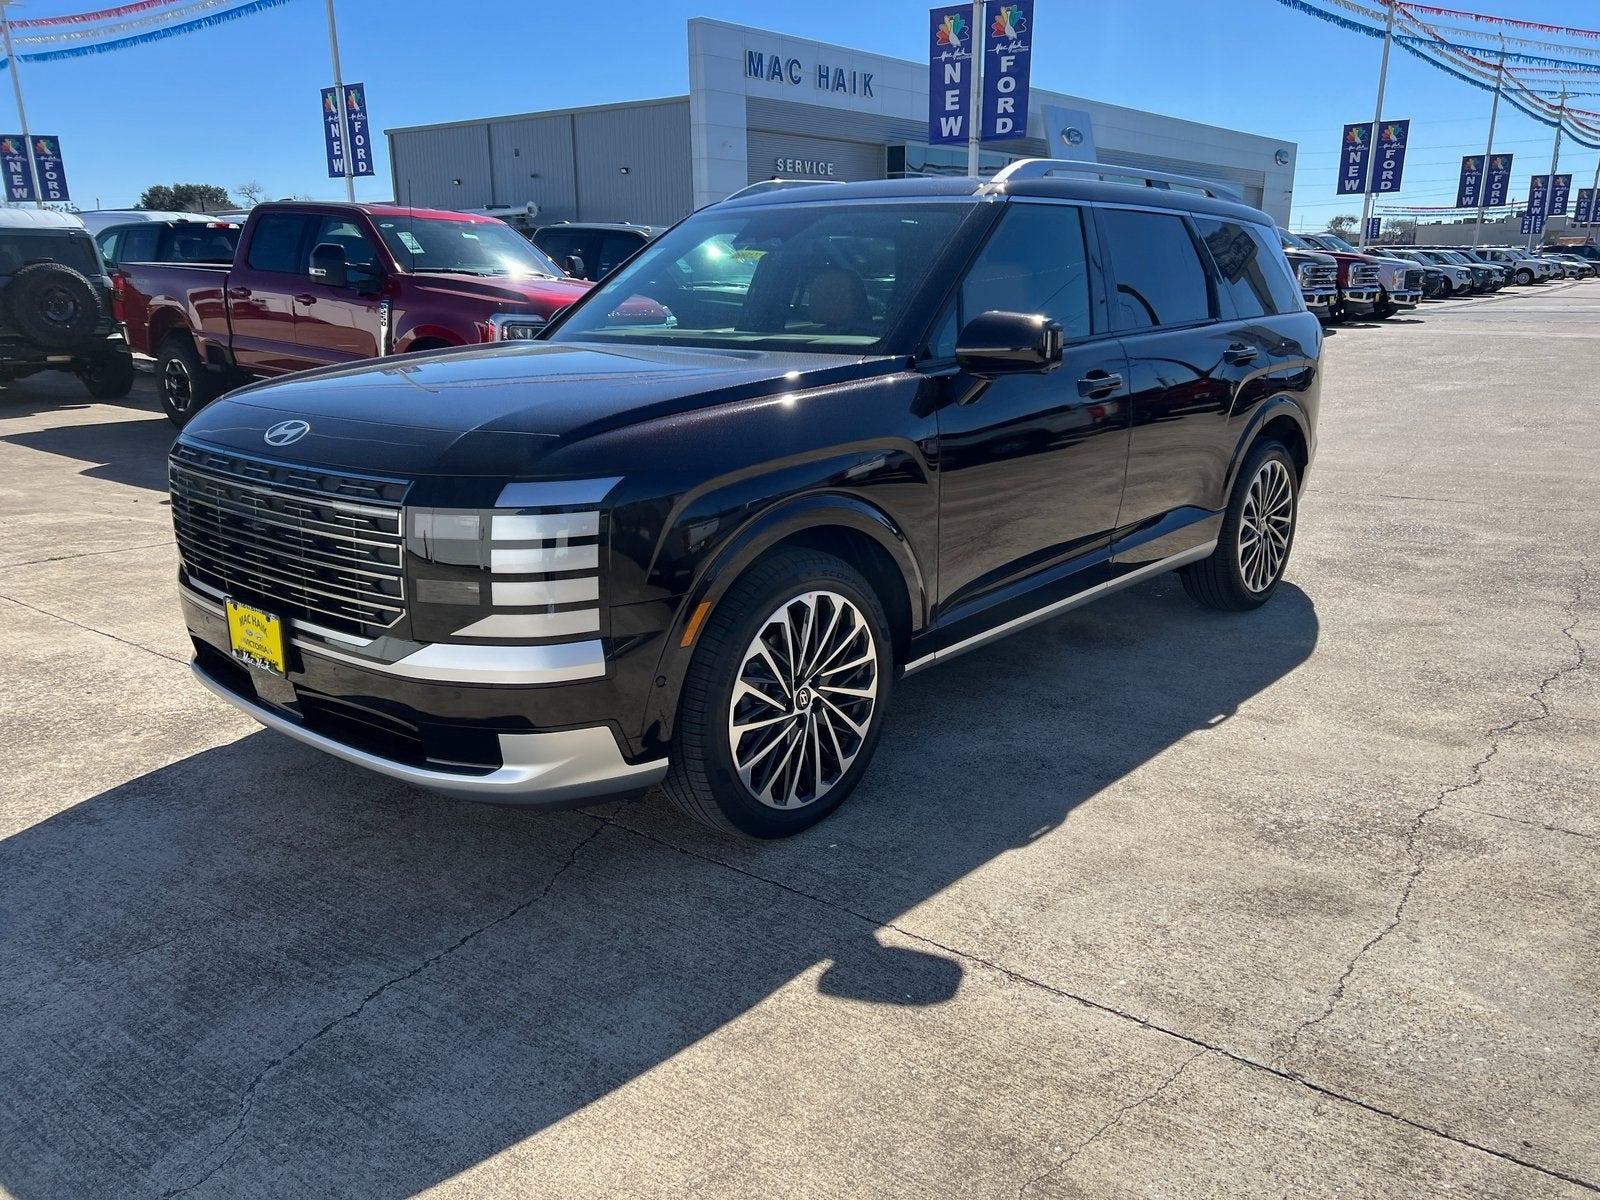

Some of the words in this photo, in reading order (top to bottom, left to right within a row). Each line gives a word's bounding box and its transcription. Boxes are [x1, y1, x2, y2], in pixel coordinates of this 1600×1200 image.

[746, 50, 802, 85] MAC
[817, 64, 874, 97] HAIK
[940, 62, 963, 137] NEW
[996, 56, 1016, 134] FORD
[331, 123, 344, 172] NEW
[354, 121, 367, 172] FORD
[9, 161, 28, 198] NEW
[44, 161, 61, 198] FORD
[777, 158, 834, 175] SERVICE
[1344, 152, 1361, 190] NEW
[1380, 149, 1396, 190] FORD
[1462, 176, 1476, 206] NEW
[1490, 175, 1503, 205] FORD
[1531, 191, 1543, 215] NEW
[1553, 190, 1564, 214] FORD
[1577, 201, 1588, 221] NEW
[239, 614, 251, 627] MAC
[252, 616, 268, 637] HAIK
